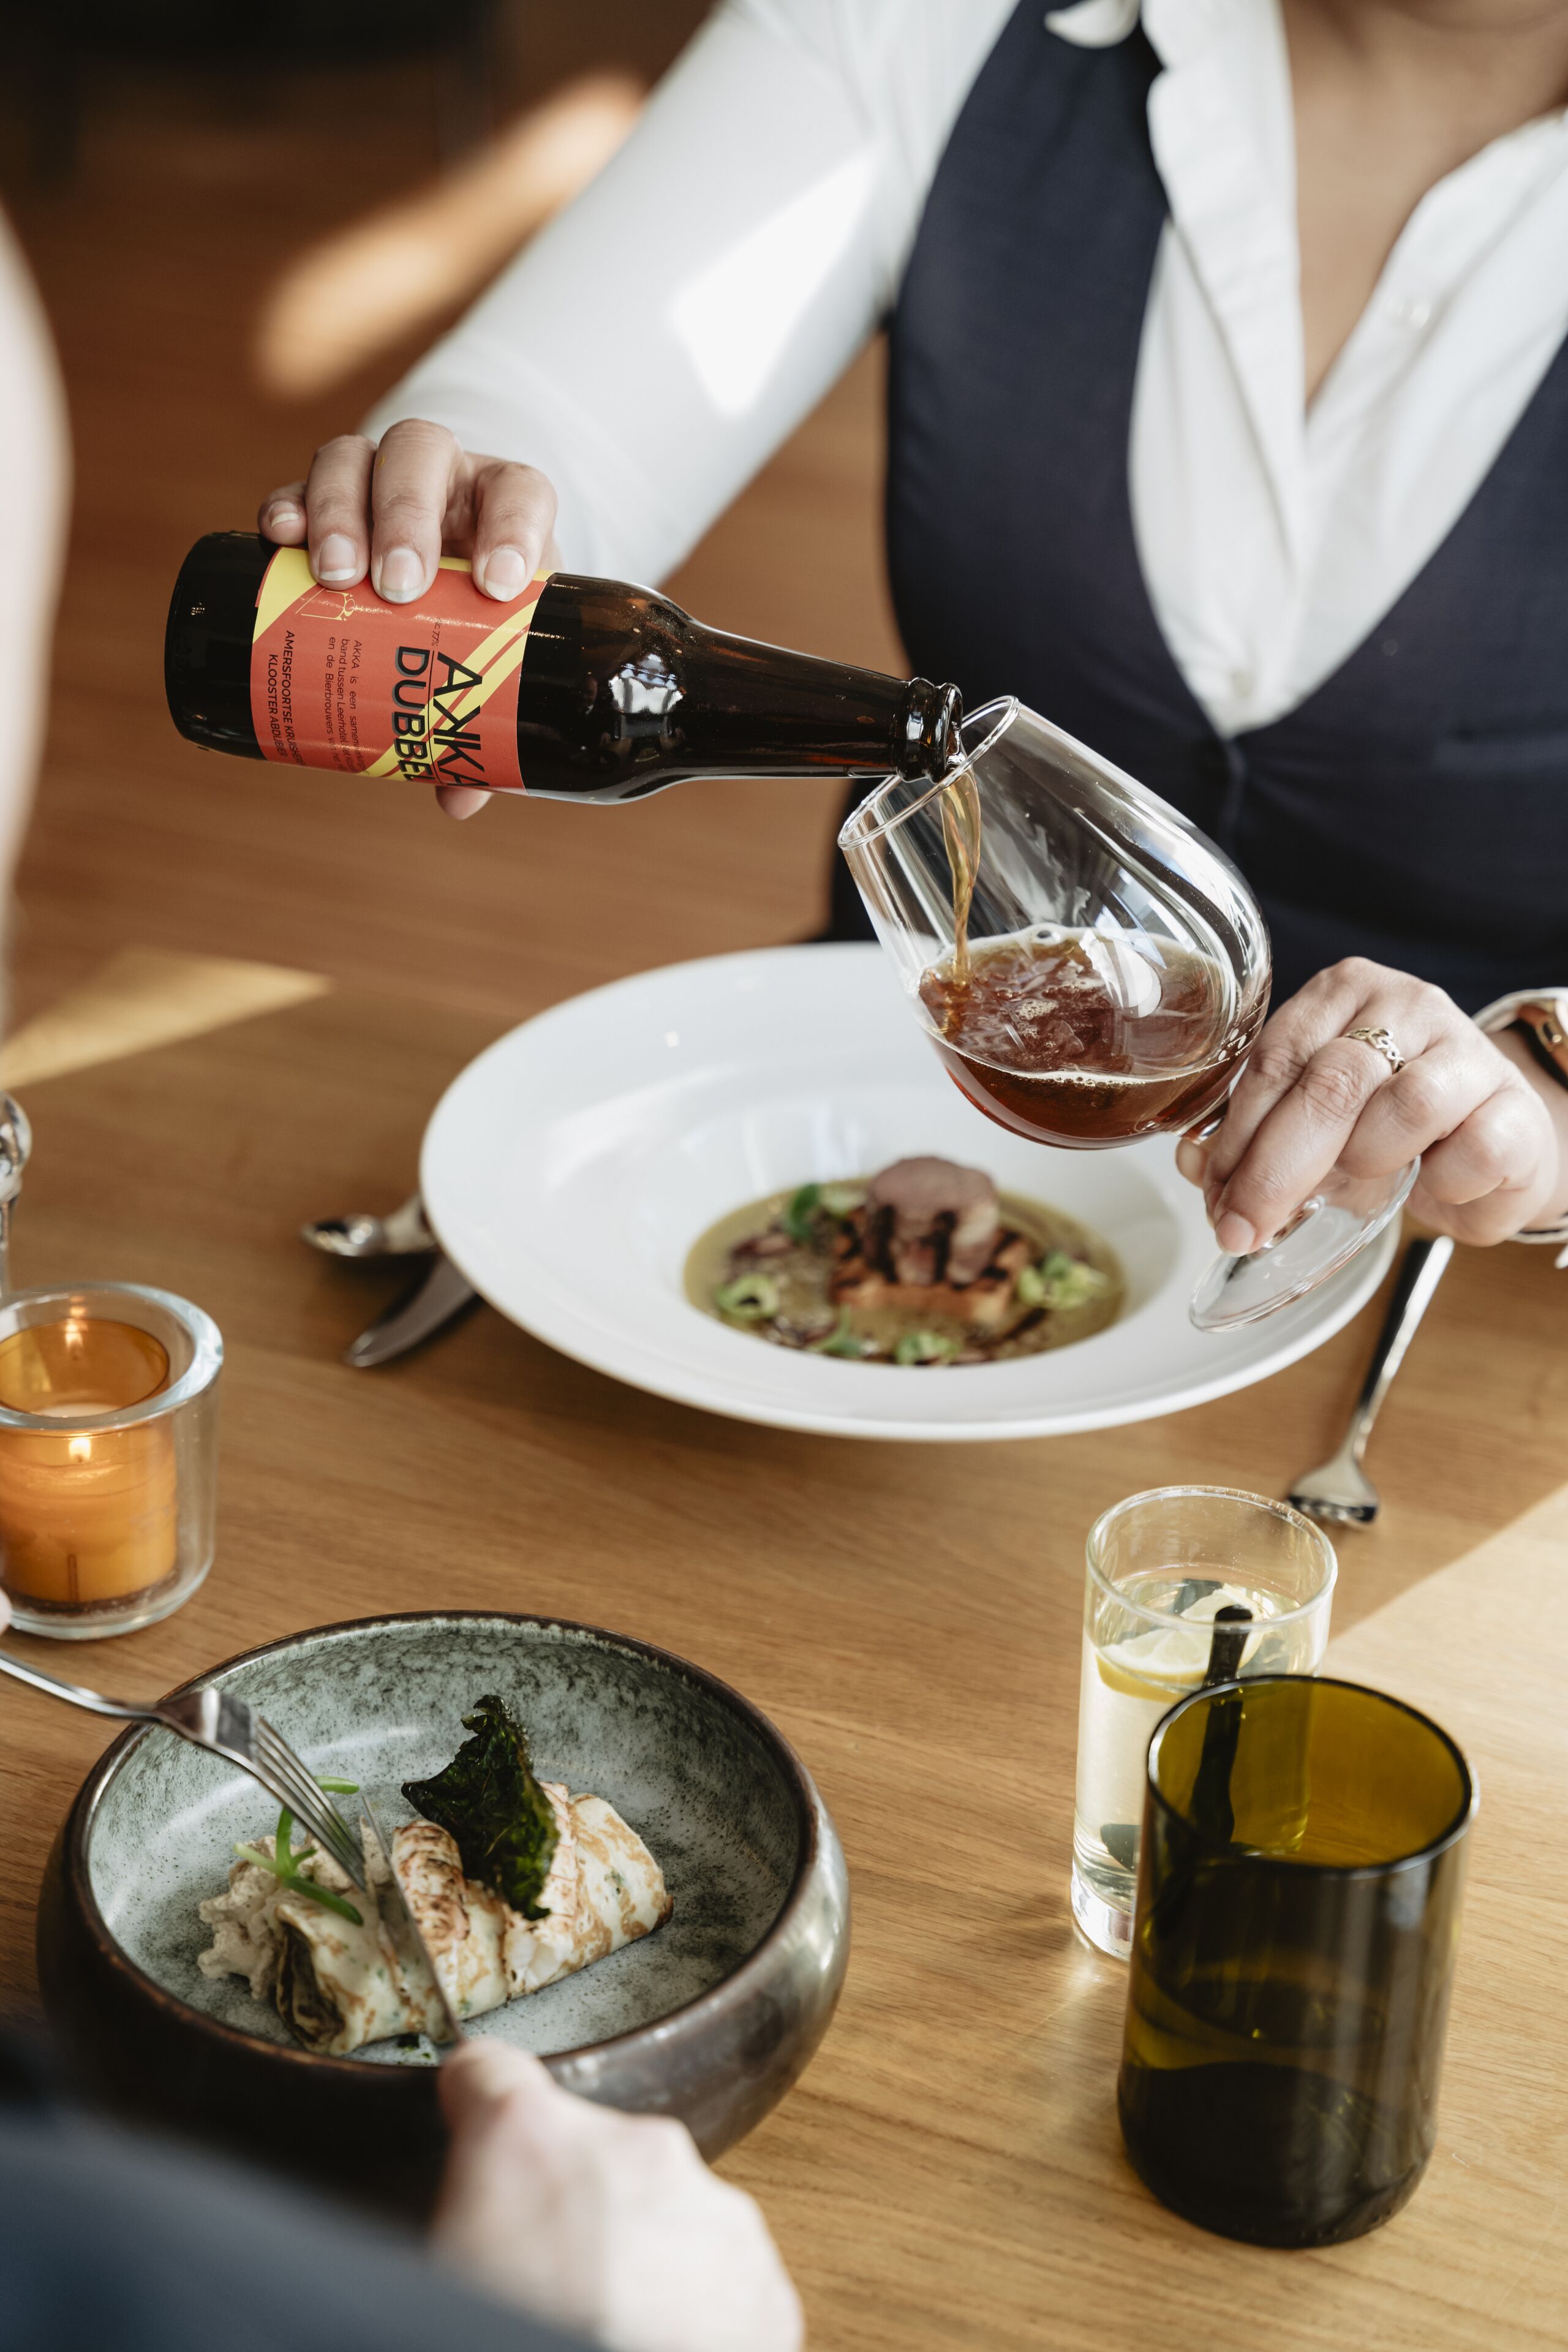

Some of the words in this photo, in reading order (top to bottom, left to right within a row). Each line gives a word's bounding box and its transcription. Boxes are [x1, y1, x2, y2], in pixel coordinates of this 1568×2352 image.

[328, 636, 336, 649] en
[339, 638, 350, 665] band
[351, 639, 362, 669] AKKA
[282, 630, 295, 724] AMERSFOORTSE
[326, 654, 335, 668] de
[268, 654, 279, 714] KLOOSTER
[337, 667, 347, 699] tussen
[350, 676, 359, 684] is
[325, 673, 334, 734] Bierbrouwers
[393, 646, 435, 781] DUBBEL
[270, 715, 288, 757] ABDIJBIER
[337, 702, 349, 743] Leerhotel
